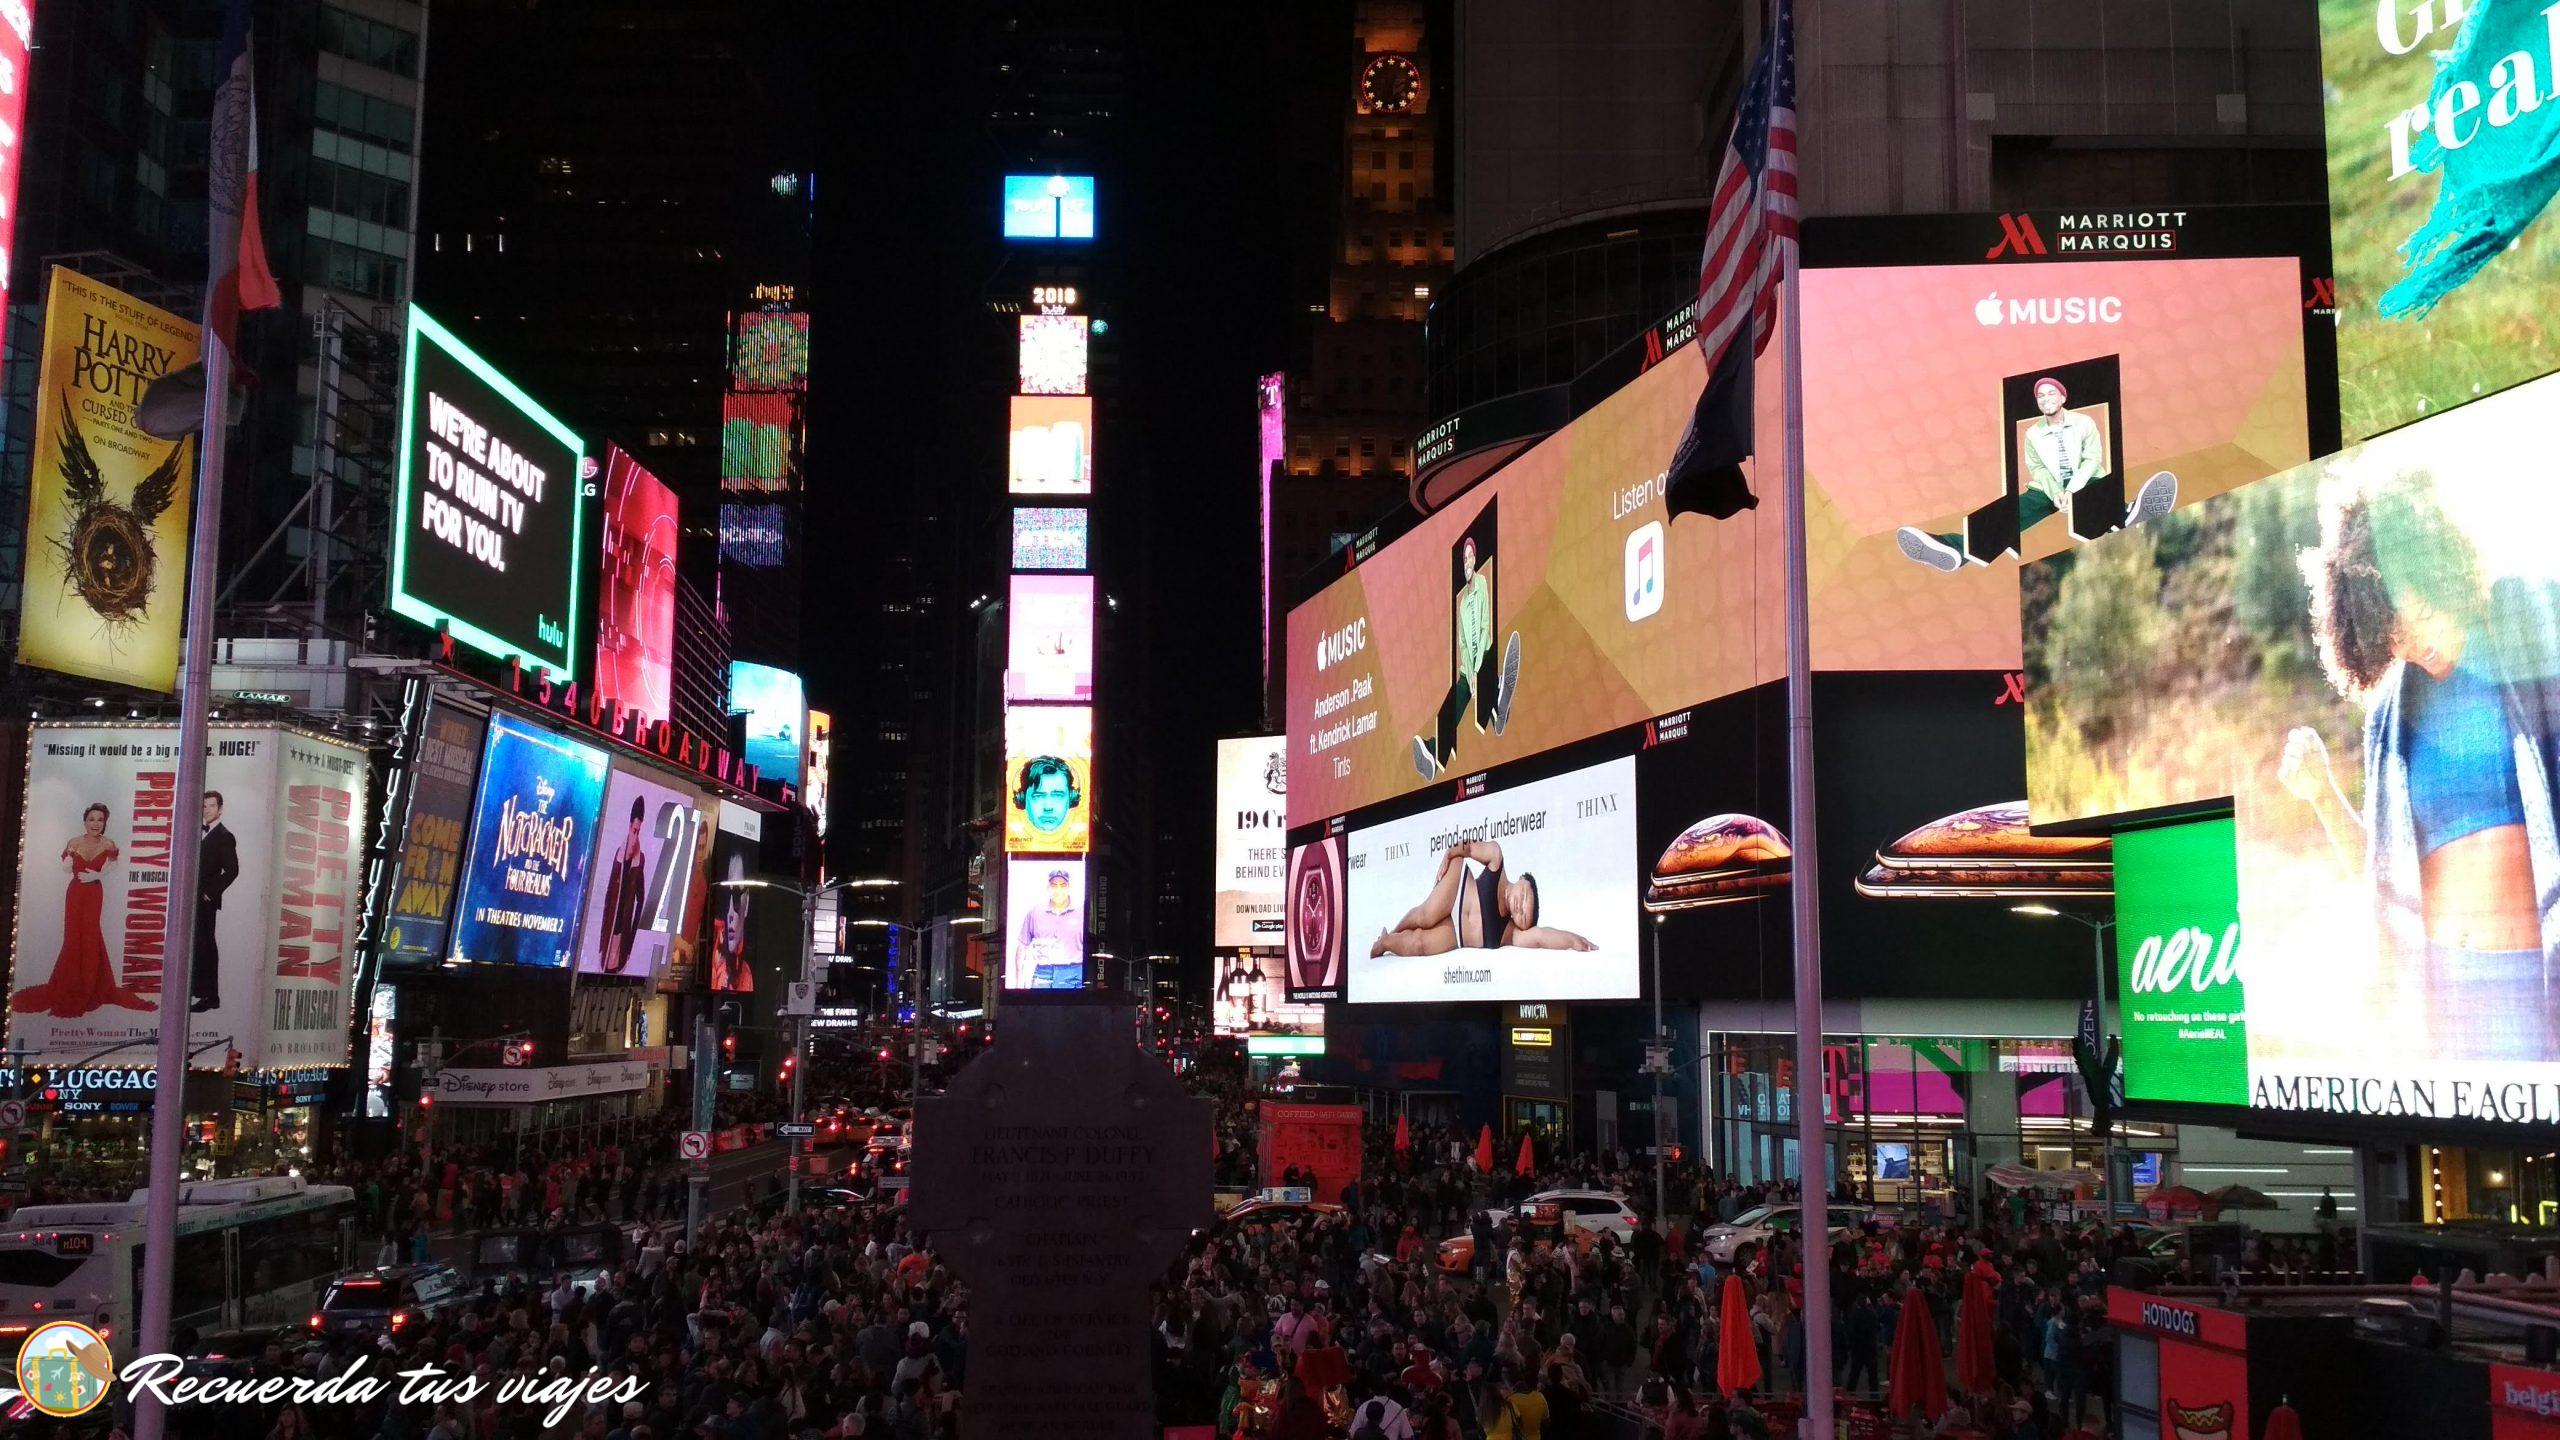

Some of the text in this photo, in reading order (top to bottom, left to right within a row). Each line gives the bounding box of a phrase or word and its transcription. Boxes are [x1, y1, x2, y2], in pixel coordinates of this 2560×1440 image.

[2060, 212, 2187, 229] MARRIOTT
[2060, 232, 2173, 251] MARQUIS
[1033, 287, 1076, 304] 2018
[90, 292, 97, 301] IS
[100, 295, 117, 310] THE
[119, 305, 144, 320] STUFF
[147, 317, 158, 328] OF
[2010, 297, 2122, 324] MUSIC
[82, 313, 175, 376] HARRY
[72, 346, 153, 406] POTT
[82, 398, 127, 425] CURSED
[110, 401, 136, 414] AND TH
[93, 418, 152, 444] PARTS ONE AND TWO
[1418, 417, 1460, 452] MARRIOTT
[93, 435, 150, 460] ON BROADWAY
[429, 391, 545, 504] WE'RE ABOUT
[1418, 438, 1453, 469] MARQUIS
[426, 442, 524, 535] TO RUIN TV
[1613, 478, 1653, 520] Listen
[422, 491, 509, 572] FOR YOU.
[1356, 527, 1378, 549] MARRIOTT
[1356, 541, 1376, 561] MARQUIS
[538, 613, 563, 648] hulu
[1328, 617, 1366, 667] MUSIC
[239, 691, 285, 702] LAMAR
[1315, 687, 1350, 720] Anderson
[511, 655, 761, 793] 1540 BROADWAY
[1318, 719, 1351, 752] Kendrick
[1352, 711, 1377, 738] Lamar
[1659, 712, 1691, 729] MARRIOTT
[1659, 725, 1688, 742] MARQUIS
[89, 744, 96, 756] it
[100, 744, 127, 756] would
[132, 744, 142, 756] be
[146, 746, 152, 756] a
[156, 744, 170, 758] big
[1333, 757, 1350, 779] Tints
[1466, 773, 1487, 785] MARRIOTT
[1466, 784, 1485, 796] MARQUIS
[538, 799, 549, 814] THE
[1577, 793, 1618, 819] THINX
[130, 771, 175, 868] PRETTY
[1237, 811, 1258, 829] 19
[411, 812, 461, 852] COME
[493, 794, 573, 882] NUTCRACKER
[1430, 809, 1546, 857] period-proof underwear
[1248, 849, 1286, 860] THERE'S
[1385, 842, 1410, 861] THINX
[129, 871, 168, 883] THE MUSICAL
[650, 803, 701, 934] 21
[1236, 866, 1269, 878] BEHIND
[276, 785, 321, 977] WOMAN
[309, 786, 352, 987] PRETTY
[505, 865, 552, 897] FOUR REALMS
[396, 880, 451, 917] AWAY
[1236, 904, 1272, 913] DOWNLOAD
[475, 908, 564, 932] IN THEATRES NOVEMBER 2
[121, 886, 168, 993] WOMAN
[2131, 922, 2244, 994] aeri
[1443, 966, 1491, 987] shethinx.com
[273, 988, 339, 1030] THE MUSICAL
[1520, 1004, 1548, 1019] INVICTA
[51, 1027, 219, 1038] PrettyWomanTheM.com
[270, 1043, 282, 1054] ON
[284, 1066, 329, 1084] LUGGAGE
[498, 1081, 530, 1092] store
[58, 1089, 82, 1101] NY
[64, 1102, 101, 1111] SONY
[2252, 1075, 2435, 1117] AMERICAN
[984, 1126, 1141, 1141] LIEUTENANT COLONEL
[971, 1146, 1156, 1165] FRANCIS DUFFY
[994, 1194, 1130, 1210] CATHOLIC PRIEST
[63, 1237, 87, 1249] M104
[1025, 1232, 1097, 1247] CHAPLAIN
[2143, 1303, 2195, 1335] HOTDOGS
